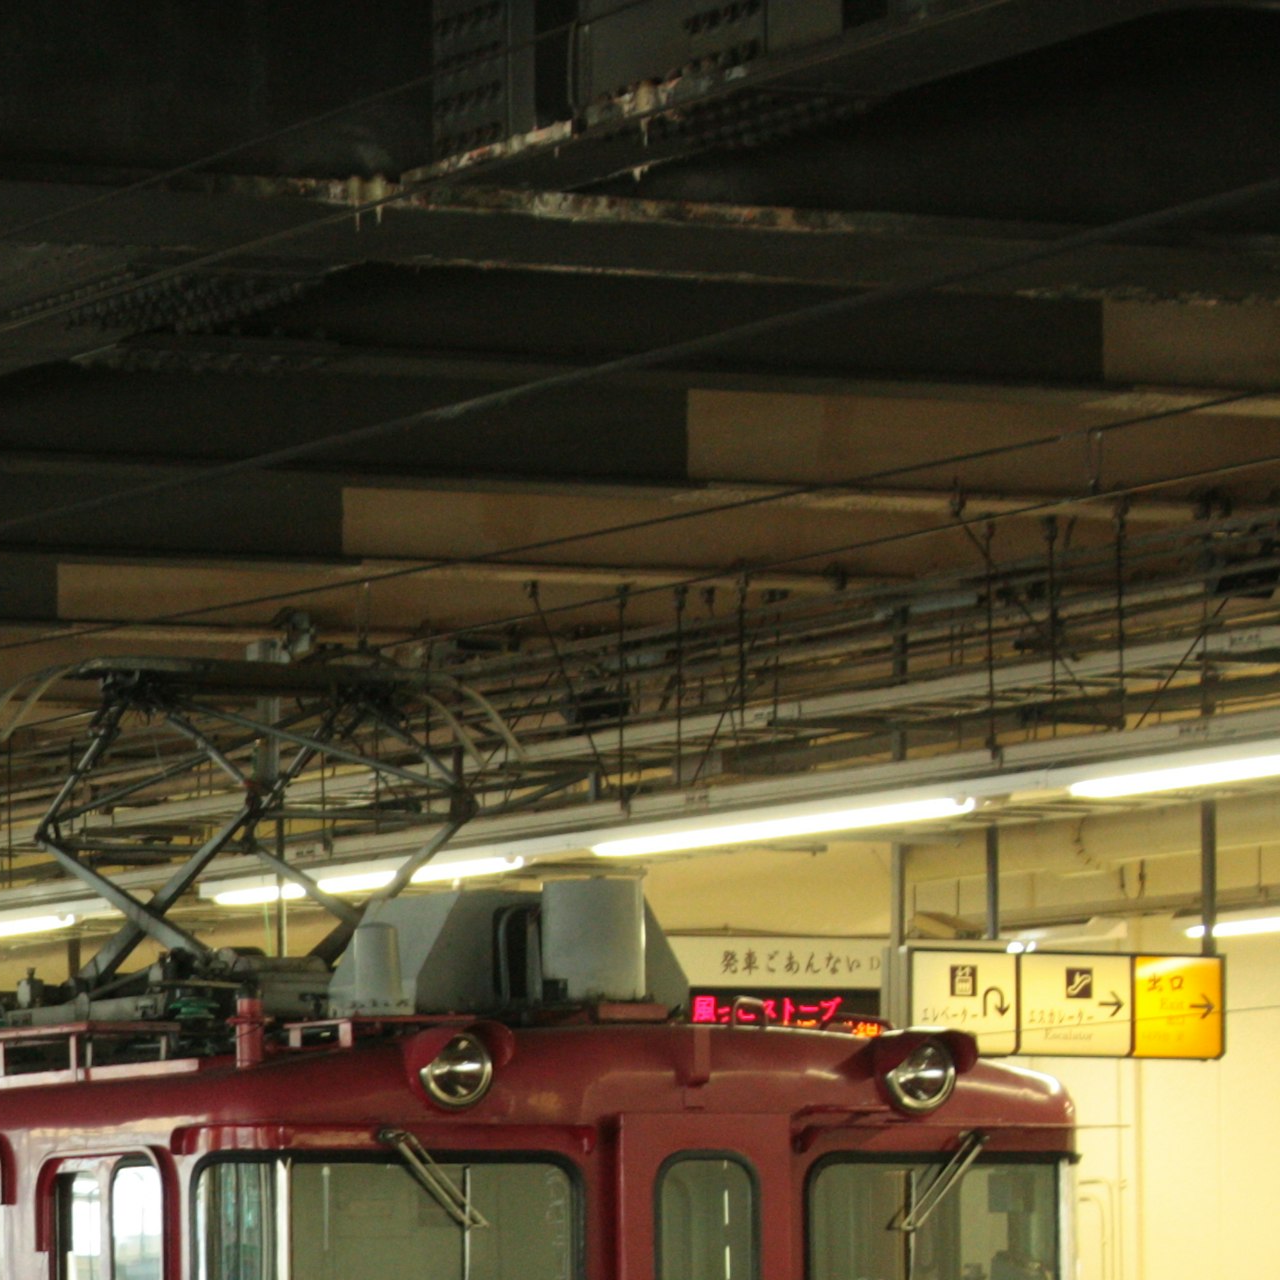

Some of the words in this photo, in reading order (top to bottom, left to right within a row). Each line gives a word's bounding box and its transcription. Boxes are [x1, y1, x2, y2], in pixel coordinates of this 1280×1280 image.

[720, 949, 862, 975] 発車ごあんない
[1147, 975, 1184, 992] 出口
[1028, 1008, 1094, 1025] エスカレーター
